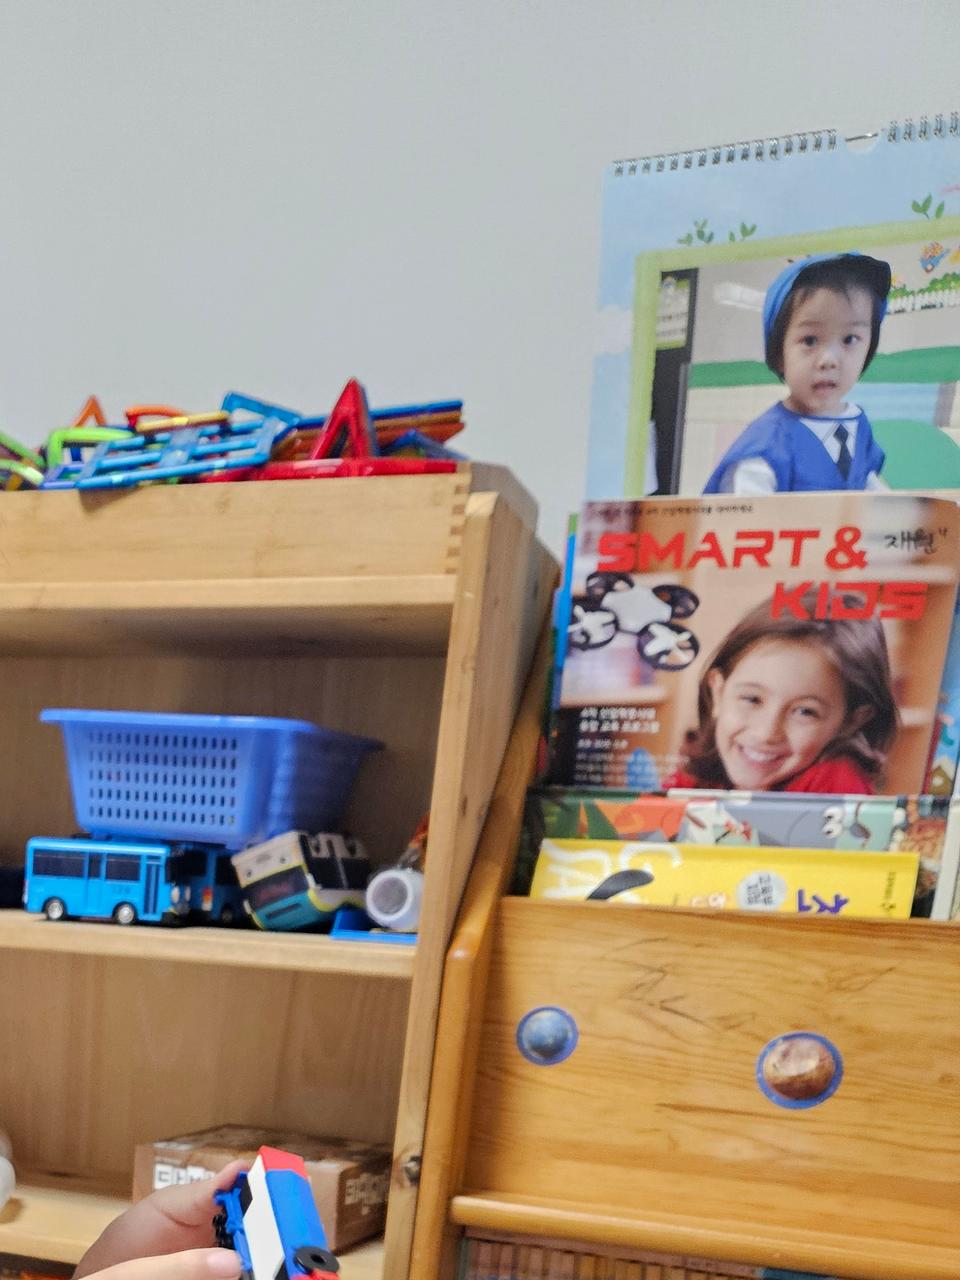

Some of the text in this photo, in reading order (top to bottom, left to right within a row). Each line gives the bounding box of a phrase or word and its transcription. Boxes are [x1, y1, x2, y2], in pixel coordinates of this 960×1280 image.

[596, 526, 868, 572] SMART &
[770, 581, 929, 621] KIDS
